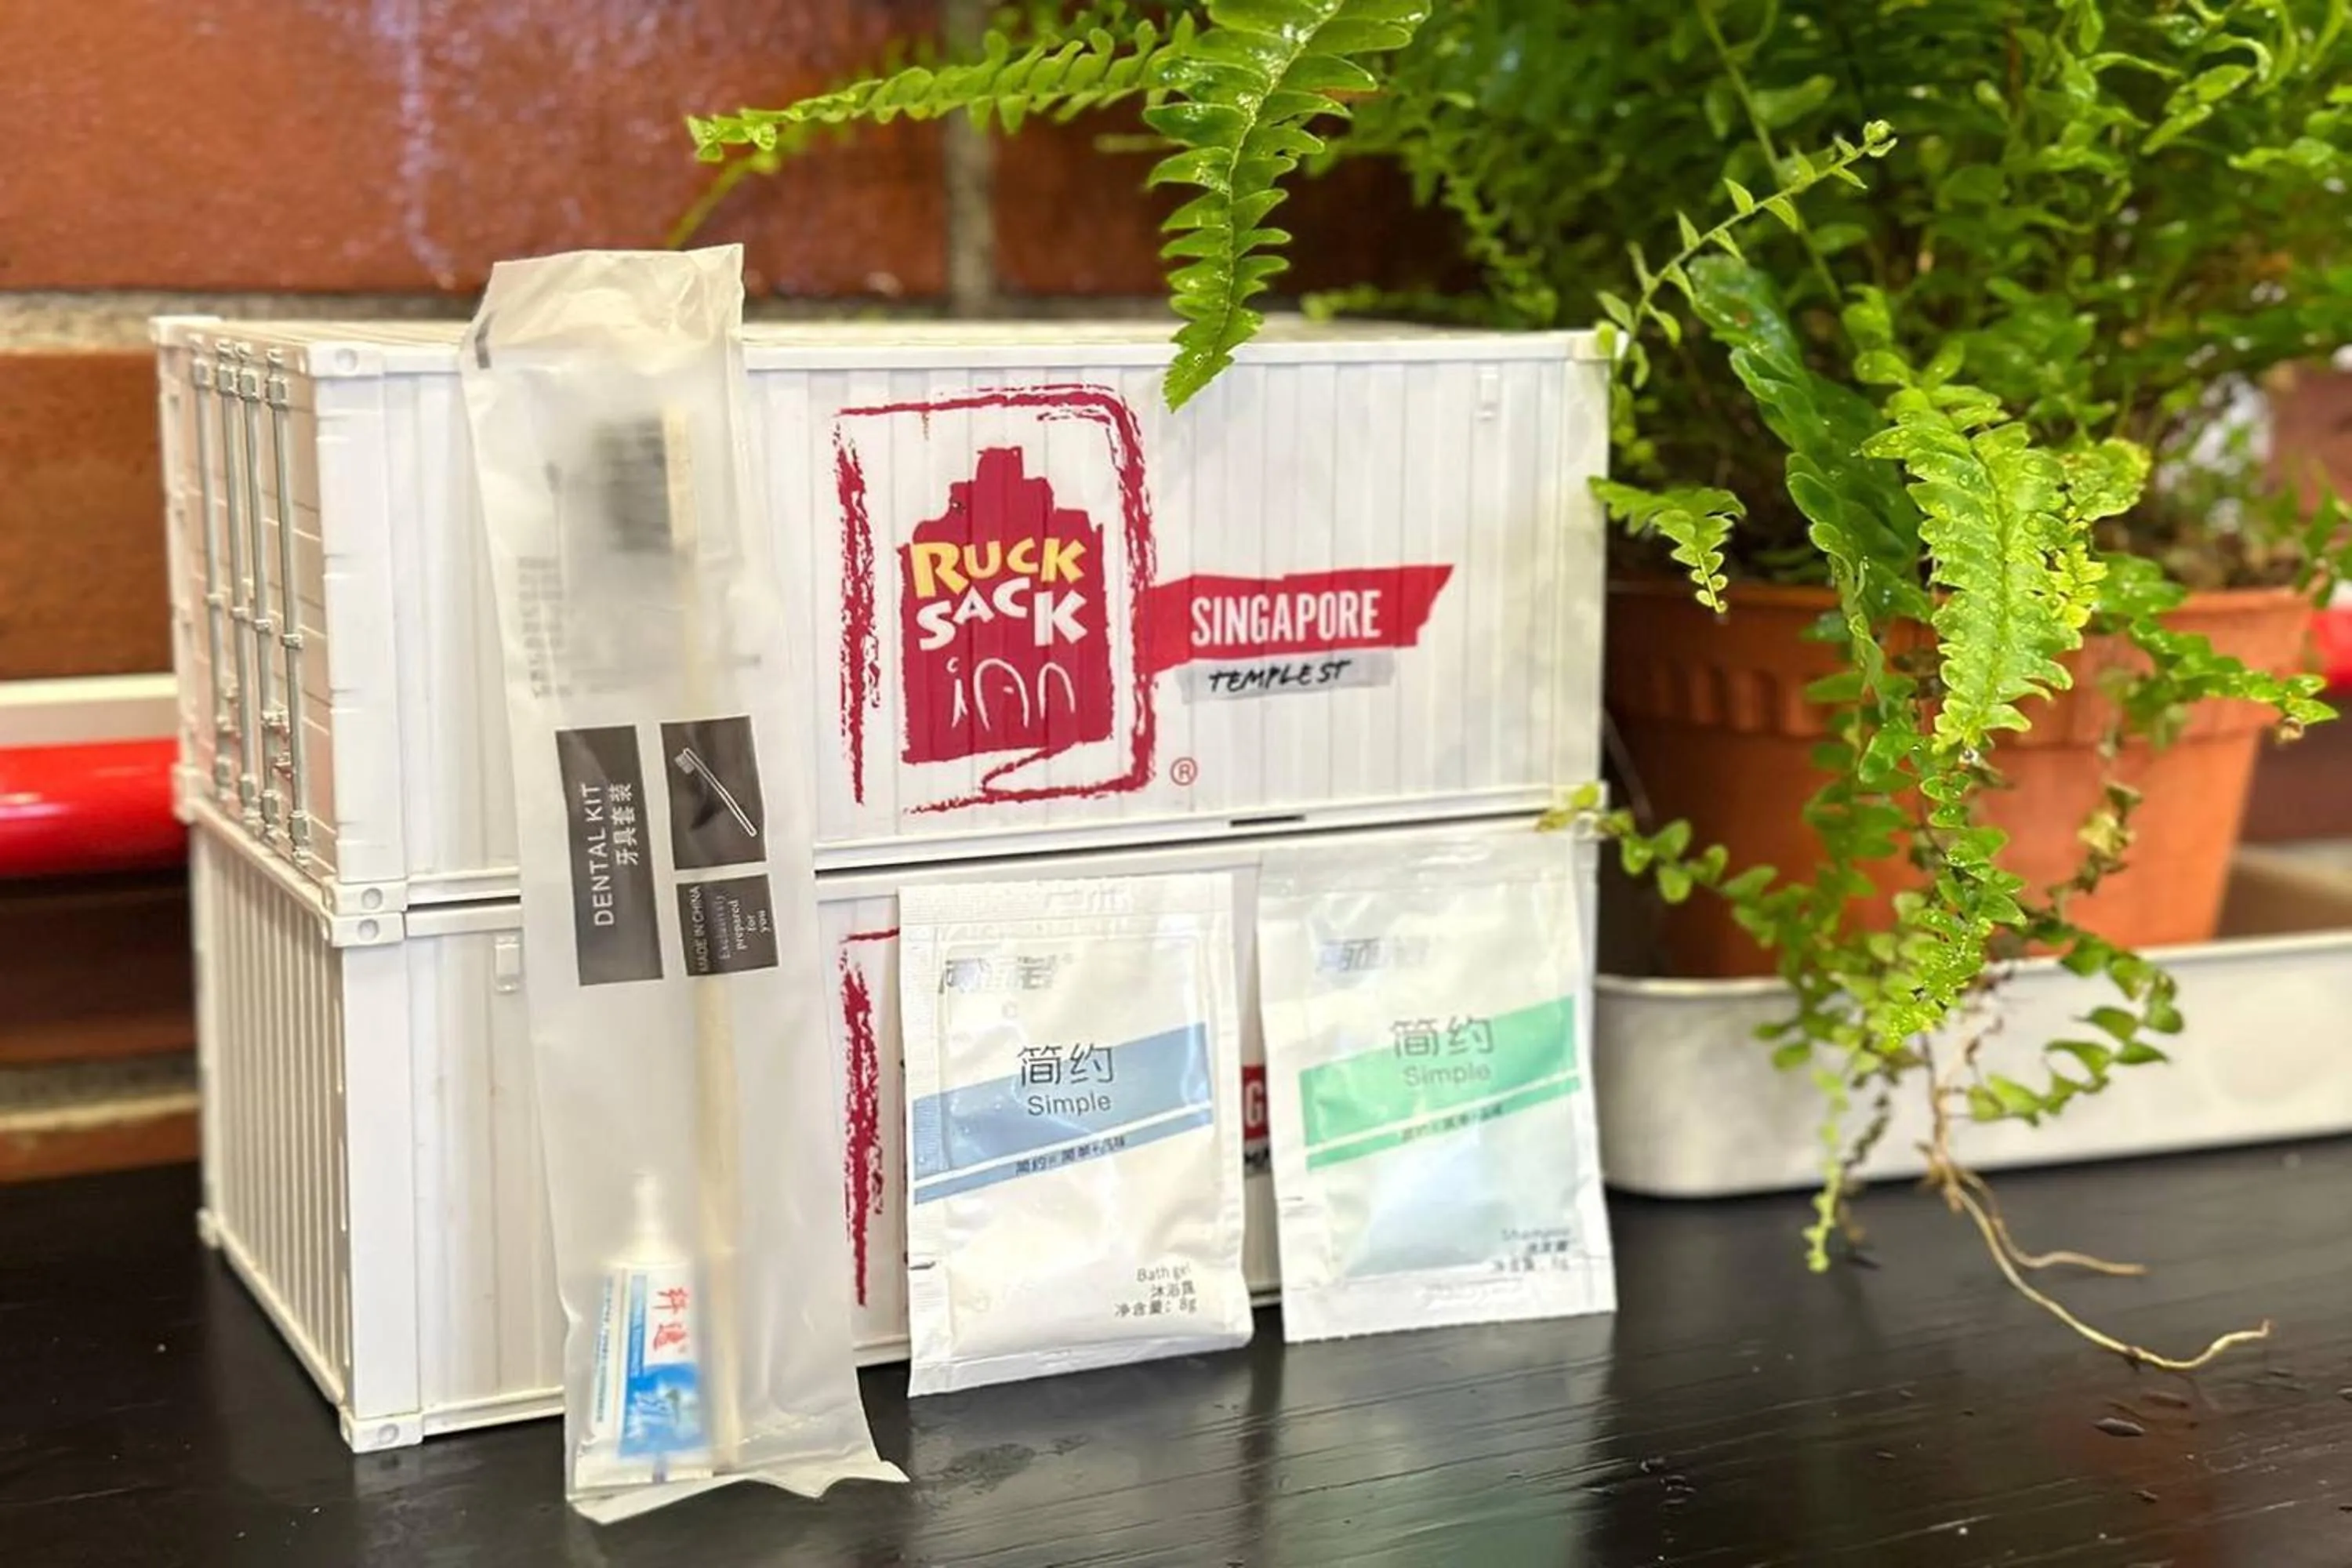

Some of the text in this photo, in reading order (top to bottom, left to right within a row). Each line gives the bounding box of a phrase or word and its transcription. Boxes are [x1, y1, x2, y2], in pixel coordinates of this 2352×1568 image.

[910, 538, 1087, 599] RUCK
[916, 577, 1088, 651] SACK
[1190, 590, 1382, 646] SINGAPORE
[582, 783, 615, 927] DENTAL KIT
[688, 885, 710, 972] MADE IN CHINA
[728, 899, 748, 951] prepared
[746, 915, 758, 931] for
[757, 909, 771, 933] you
[1390, 1015, 1494, 1058] 简约
[1018, 1043, 1113, 1087] 简约
[1403, 1063, 1490, 1087] Simple
[1028, 1091, 1111, 1116] Simple
[1136, 1265, 1170, 1283] Bath
